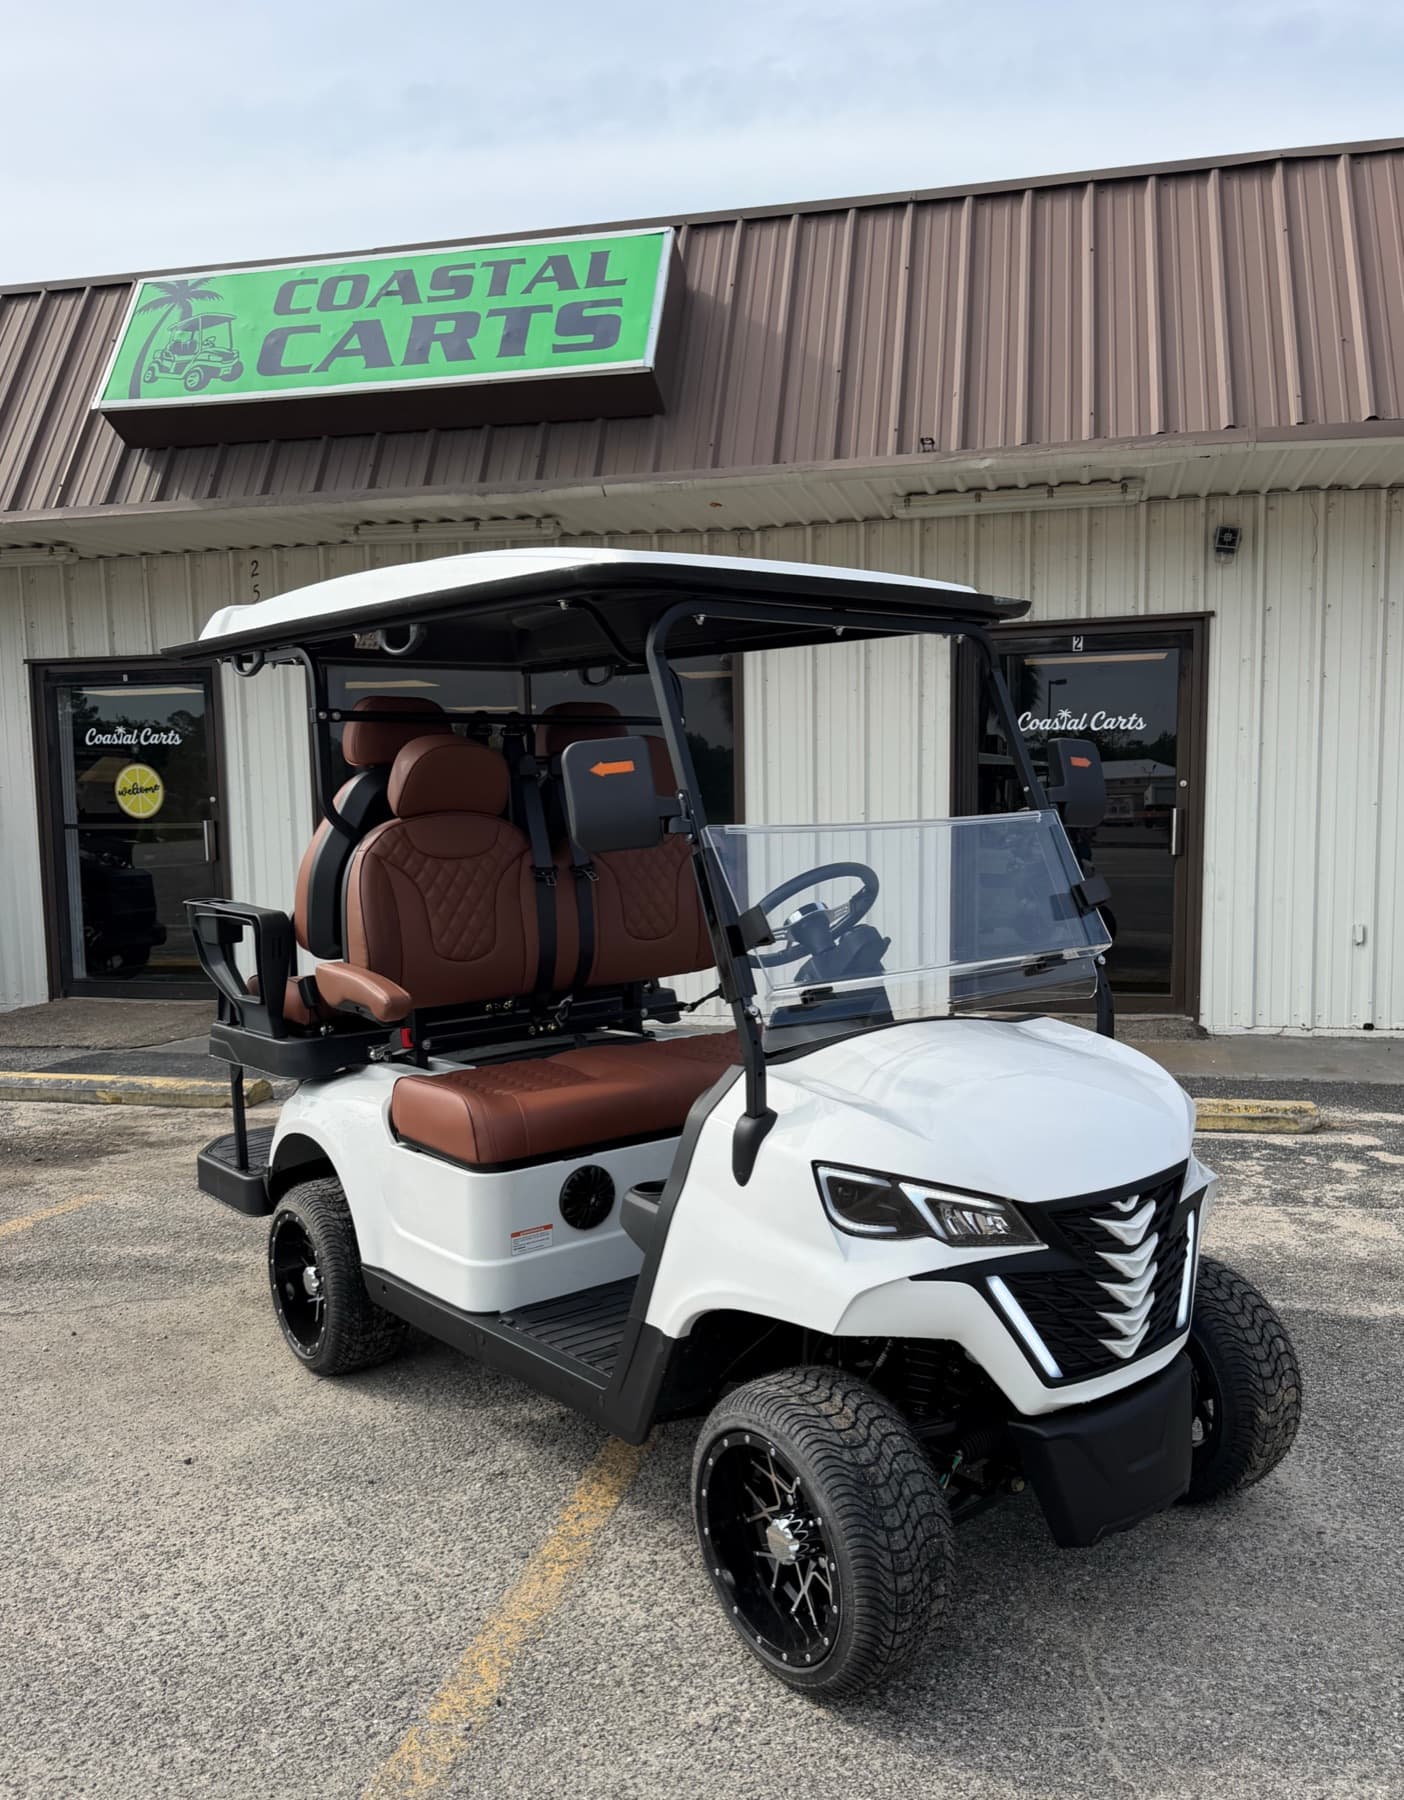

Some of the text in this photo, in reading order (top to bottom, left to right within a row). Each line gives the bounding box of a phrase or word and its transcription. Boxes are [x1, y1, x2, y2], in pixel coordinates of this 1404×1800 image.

[273, 251, 628, 315] COASTAL
[257, 298, 623, 377] CARTS
[1073, 636, 1083, 652] 2
[1017, 709, 1147, 732] Coastal Carts
[85, 726, 182, 745] Coastal Carts
